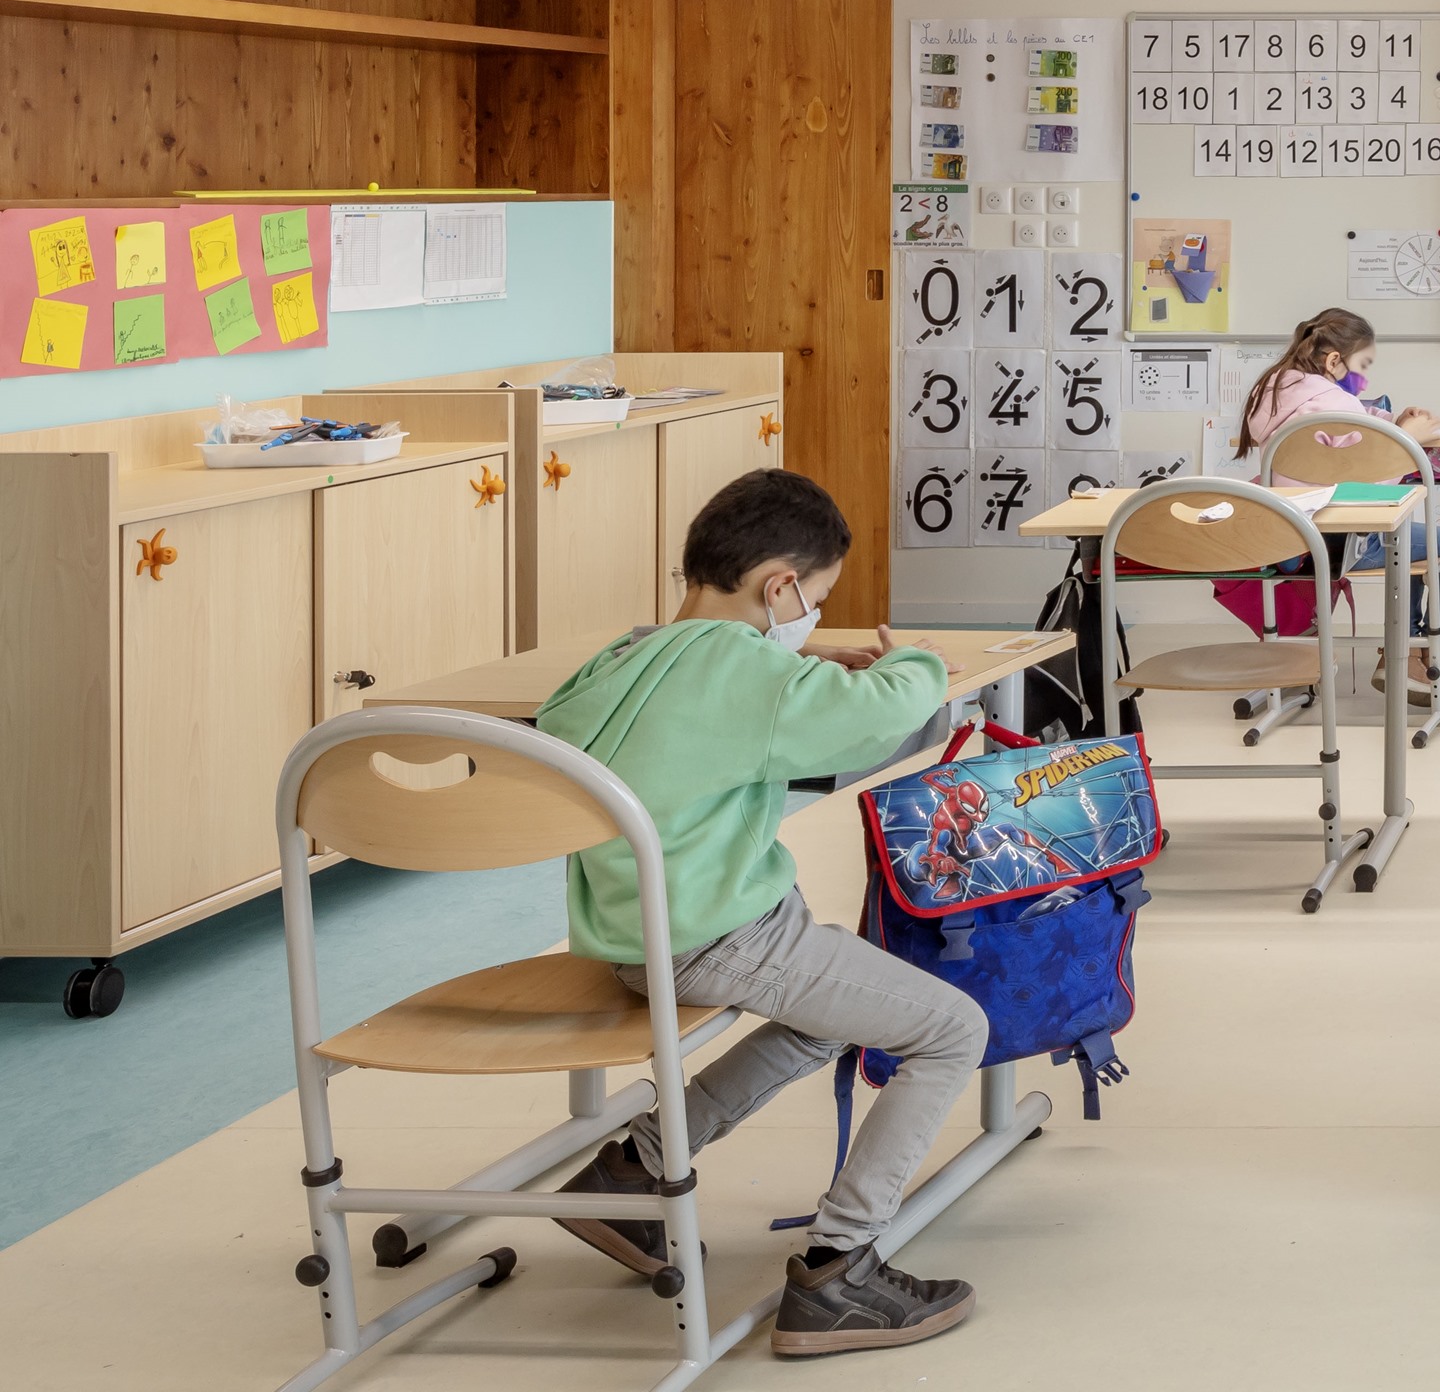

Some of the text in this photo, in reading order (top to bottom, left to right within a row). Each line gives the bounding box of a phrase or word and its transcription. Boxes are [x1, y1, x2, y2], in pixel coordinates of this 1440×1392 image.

[920, 23, 940, 44] Les
[947, 28, 977, 44] billets
[987, 32, 997, 44] et
[1006, 30, 1017, 43] les
[1073, 34, 1094, 43] CE1
[1144, 34, 1415, 58] 7 5 17 8 6 9 11
[1056, 87, 1072, 96] 200
[1138, 86, 1406, 110] 18 10 1 2 13 3 4
[1201, 139, 1231, 162] 14
[1243, 140, 1273, 162] 19
[1287, 140, 1317, 163] 12
[1329, 140, 1359, 162] 15
[1368, 139, 1400, 162] 20
[900, 194, 948, 212] 2 8
[921, 267, 1108, 335] 0 1 2
[922, 374, 1104, 436] 3 4 5
[913, 474, 1028, 533] 6 7
[1049, 745, 1078, 763] MARVEL
[1014, 742, 1130, 808] SPIDER-MAN
